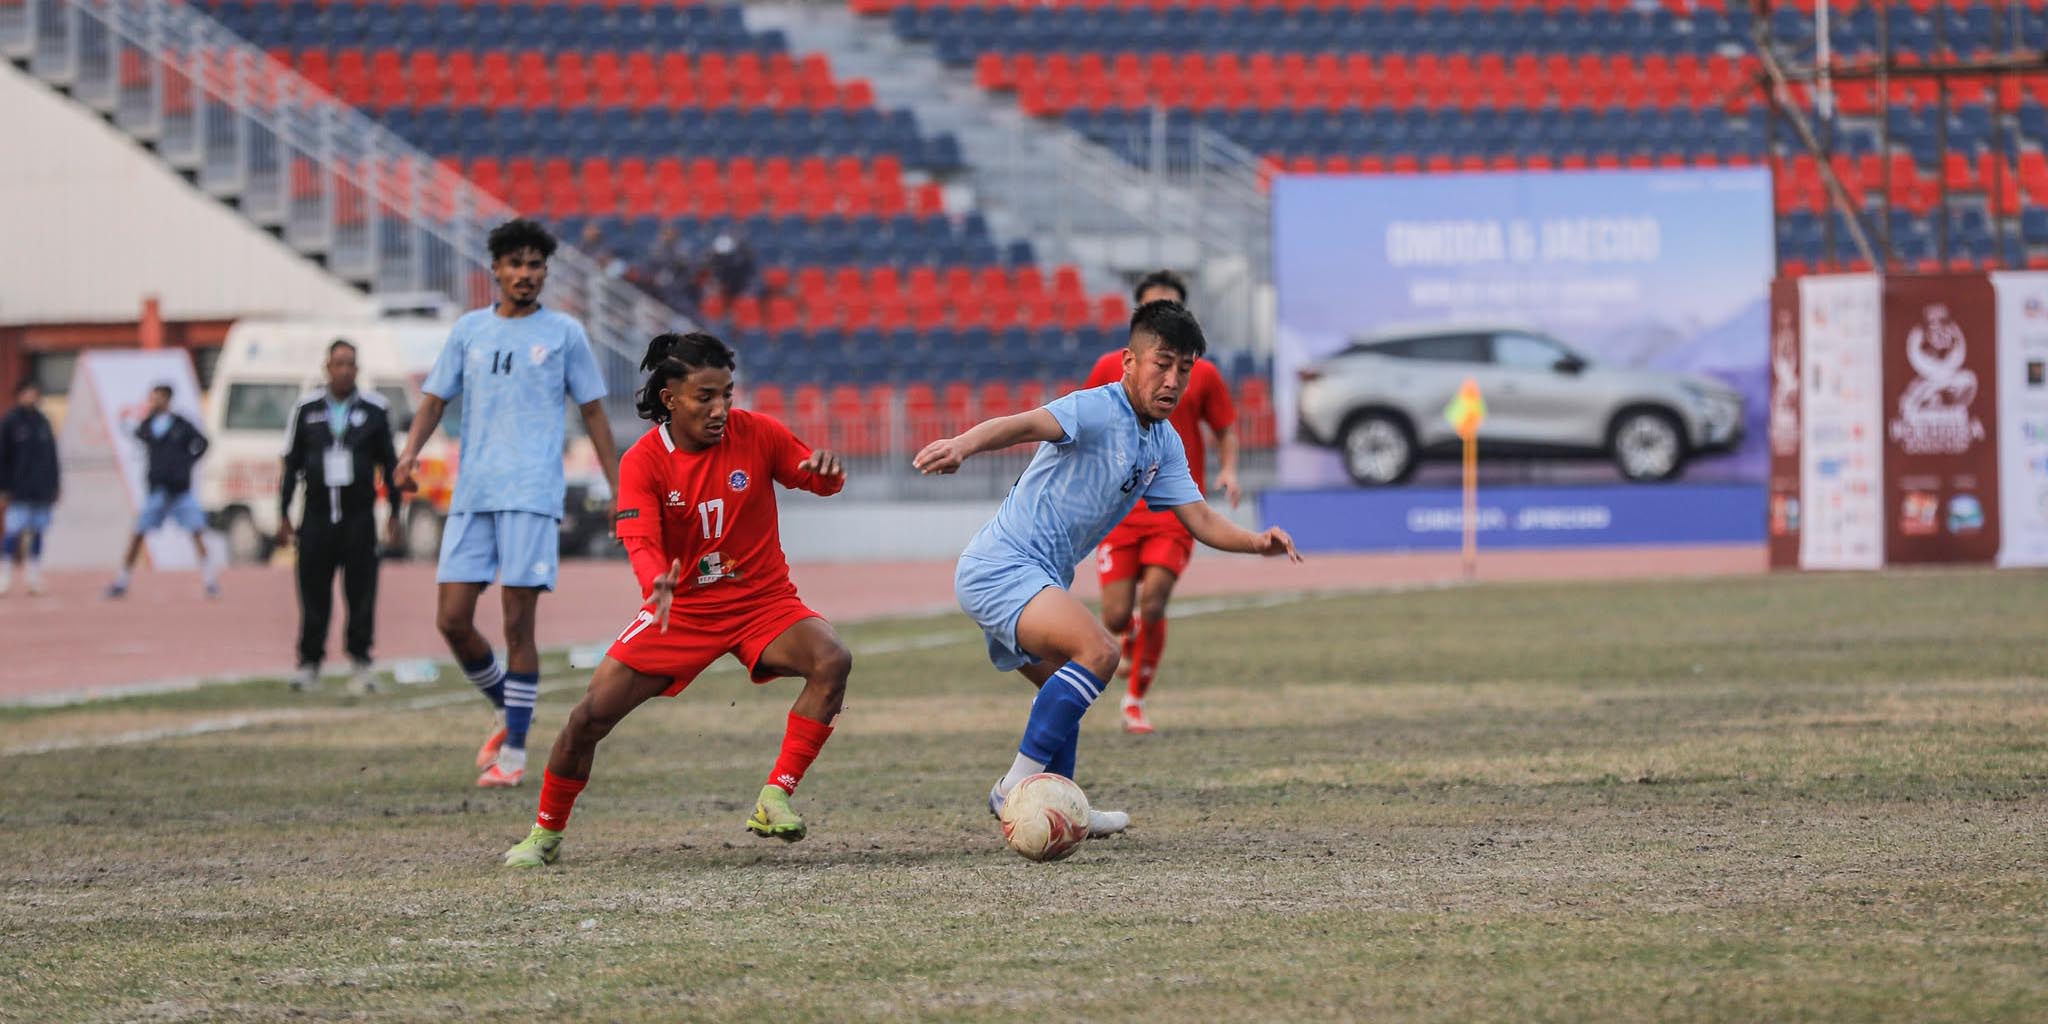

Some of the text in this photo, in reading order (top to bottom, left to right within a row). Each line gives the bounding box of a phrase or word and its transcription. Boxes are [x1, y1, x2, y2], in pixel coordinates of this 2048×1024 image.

[491, 351, 512, 376] 14
[698, 498, 724, 539] 17
[617, 610, 654, 644] 17
